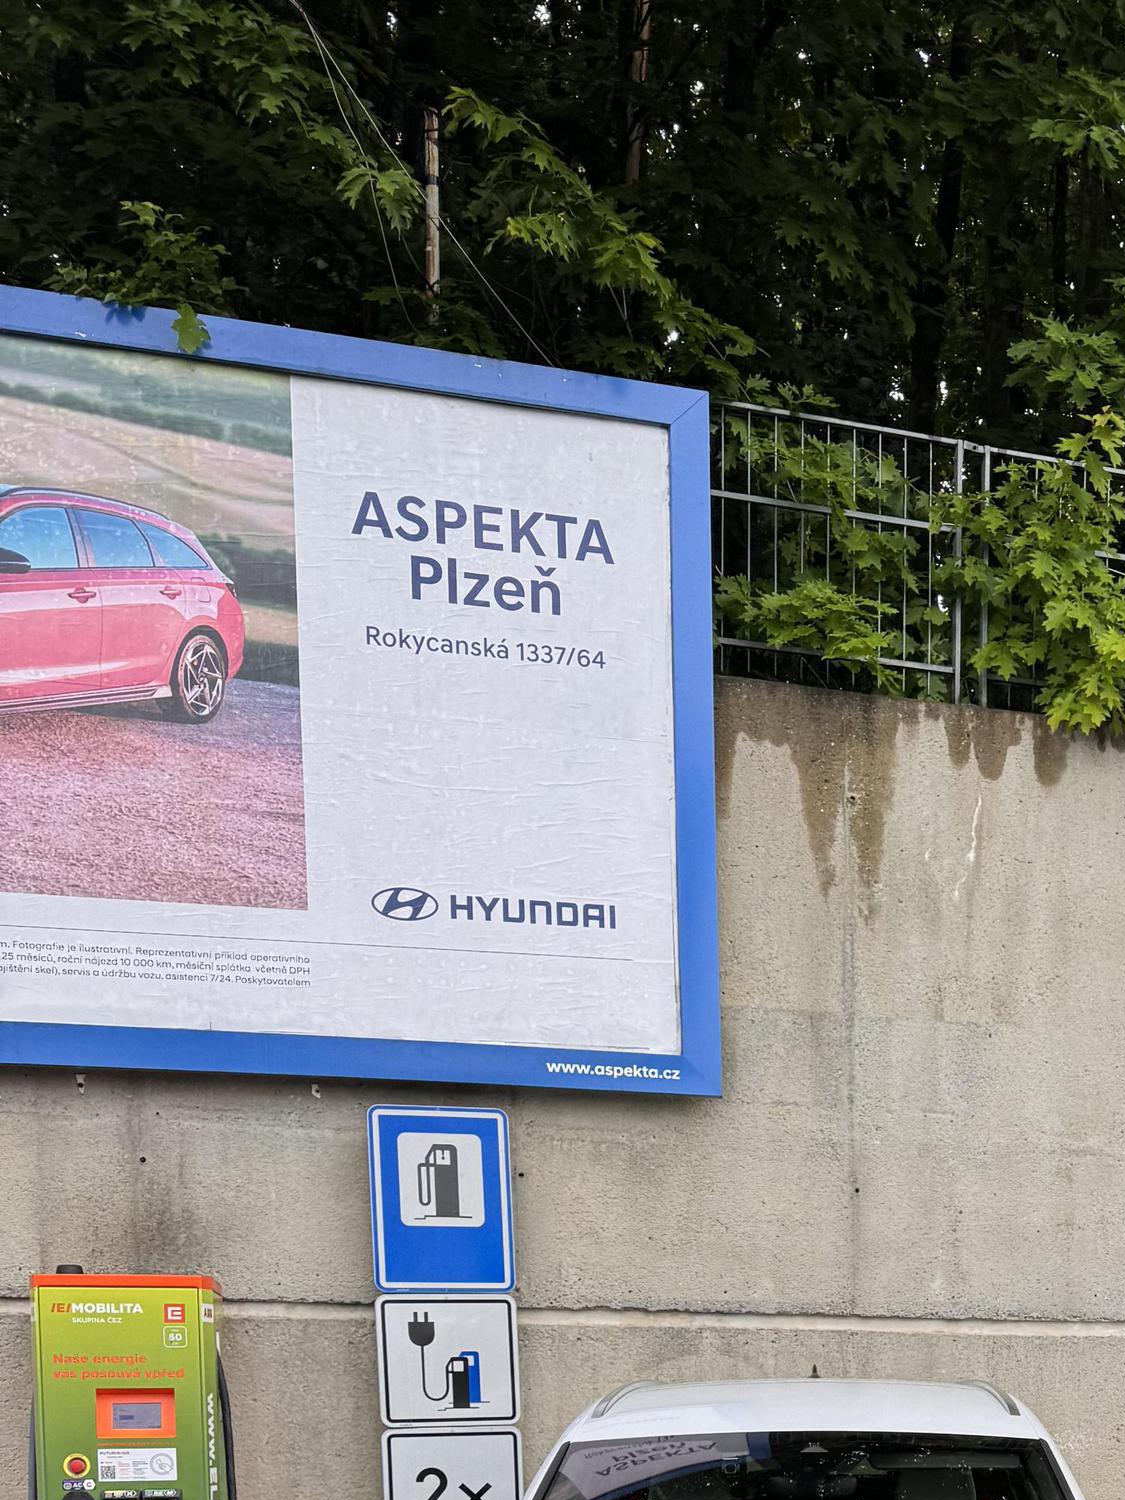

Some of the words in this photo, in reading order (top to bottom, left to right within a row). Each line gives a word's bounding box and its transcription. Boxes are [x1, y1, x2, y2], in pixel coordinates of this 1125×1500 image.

[351, 491, 615, 565] ASPEKTA
[409, 554, 562, 616] Plzeň
[366, 625, 510, 660] Rokycanská
[515, 641, 607, 670] 1337/64
[449, 895, 617, 930] HYUNDAI
[12, 940, 65, 953] Fotografie
[67, 944, 77, 953] je
[57, 954, 83, 964] roční
[85, 955, 118, 967] nájezd
[120, 958, 131, 966] 10
[133, 958, 154, 968] 000
[215, 962, 251, 975] splátka
[289, 966, 310, 975] DPH
[62, 967, 91, 976] servis
[235, 975, 311, 987] Poskytovatelem
[545, 1060, 681, 1083] www.aspekta.cz
[52, 1353, 89, 1364] Naše
[92, 1354, 148, 1367] energie
